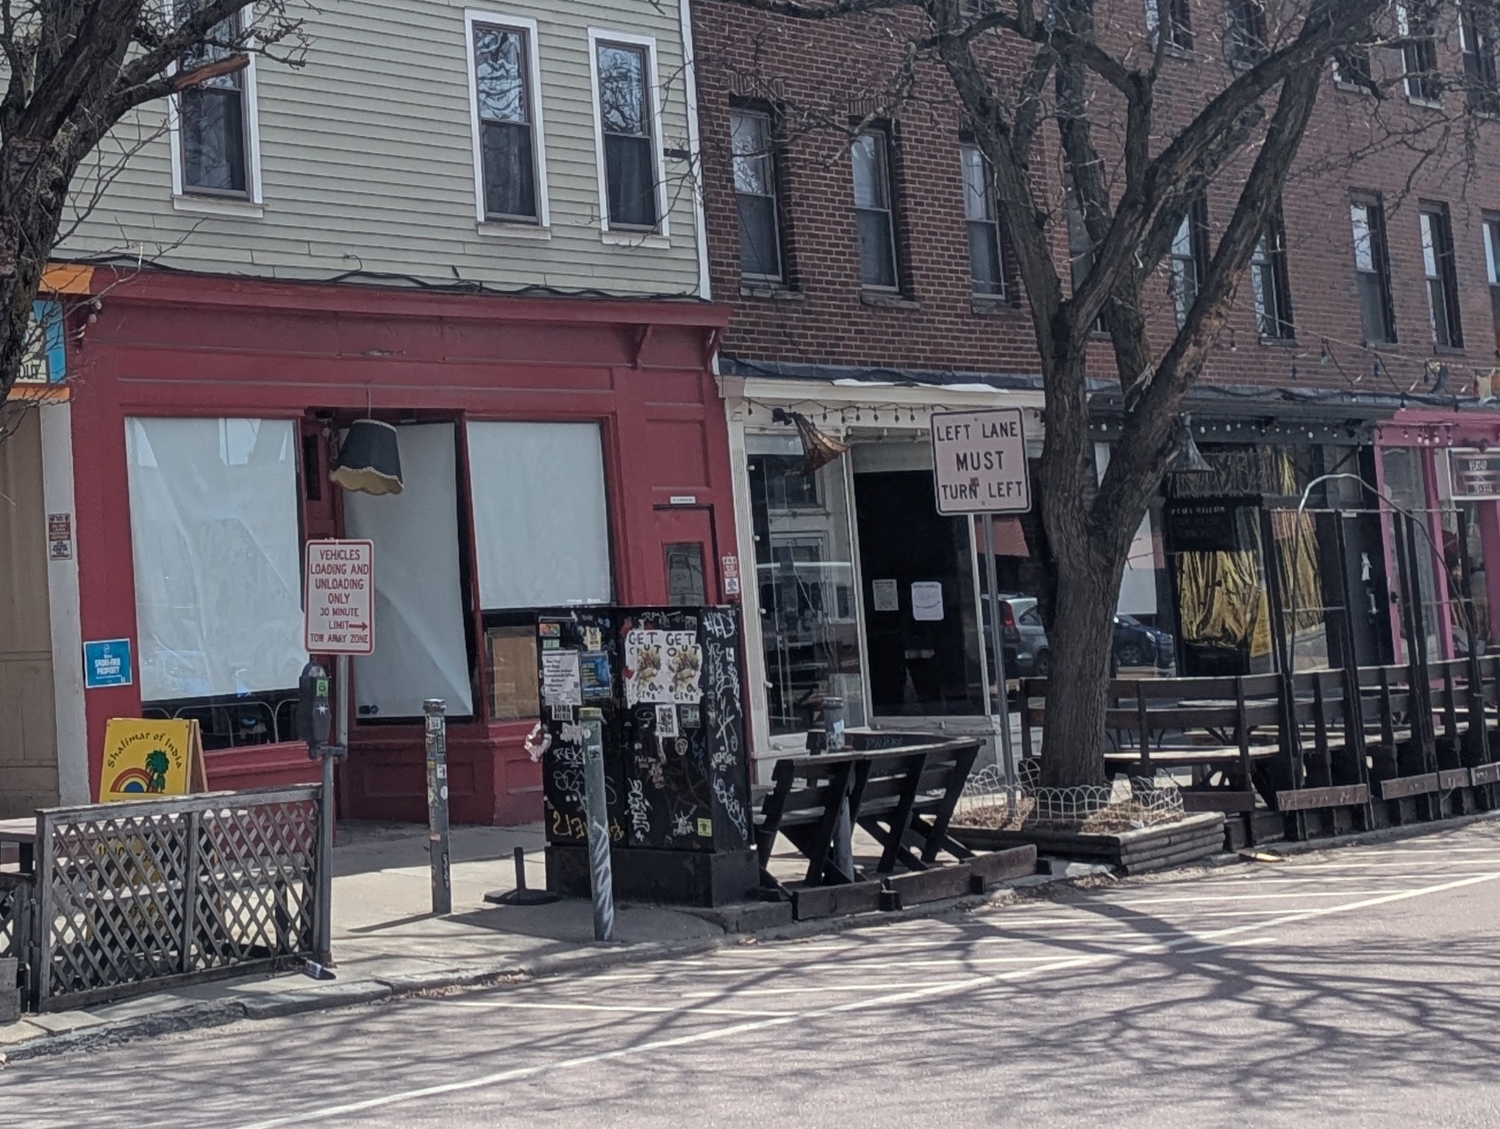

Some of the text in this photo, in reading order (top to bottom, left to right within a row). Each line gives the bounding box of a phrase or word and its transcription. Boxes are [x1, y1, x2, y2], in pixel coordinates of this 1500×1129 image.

[936, 421, 1018, 442] LEFT LANE
[956, 450, 1004, 472] MUST
[941, 481, 1023, 500] TURN LEFT
[319, 549, 361, 561] VEHICLES
[310, 563, 369, 575] LOADING AND
[315, 578, 364, 590] UNLOADING
[328, 592, 351, 604] ONLY
[320, 607, 359, 617] 30 MINUTE
[328, 620, 349, 630] LIMIT
[310, 632, 369, 644] TOW AWAY ZONE
[629, 631, 658, 646] GET
[666, 632, 695, 646] GET
[666, 644, 700, 657] OUT
[107, 732, 183, 769] Shalimar of India
